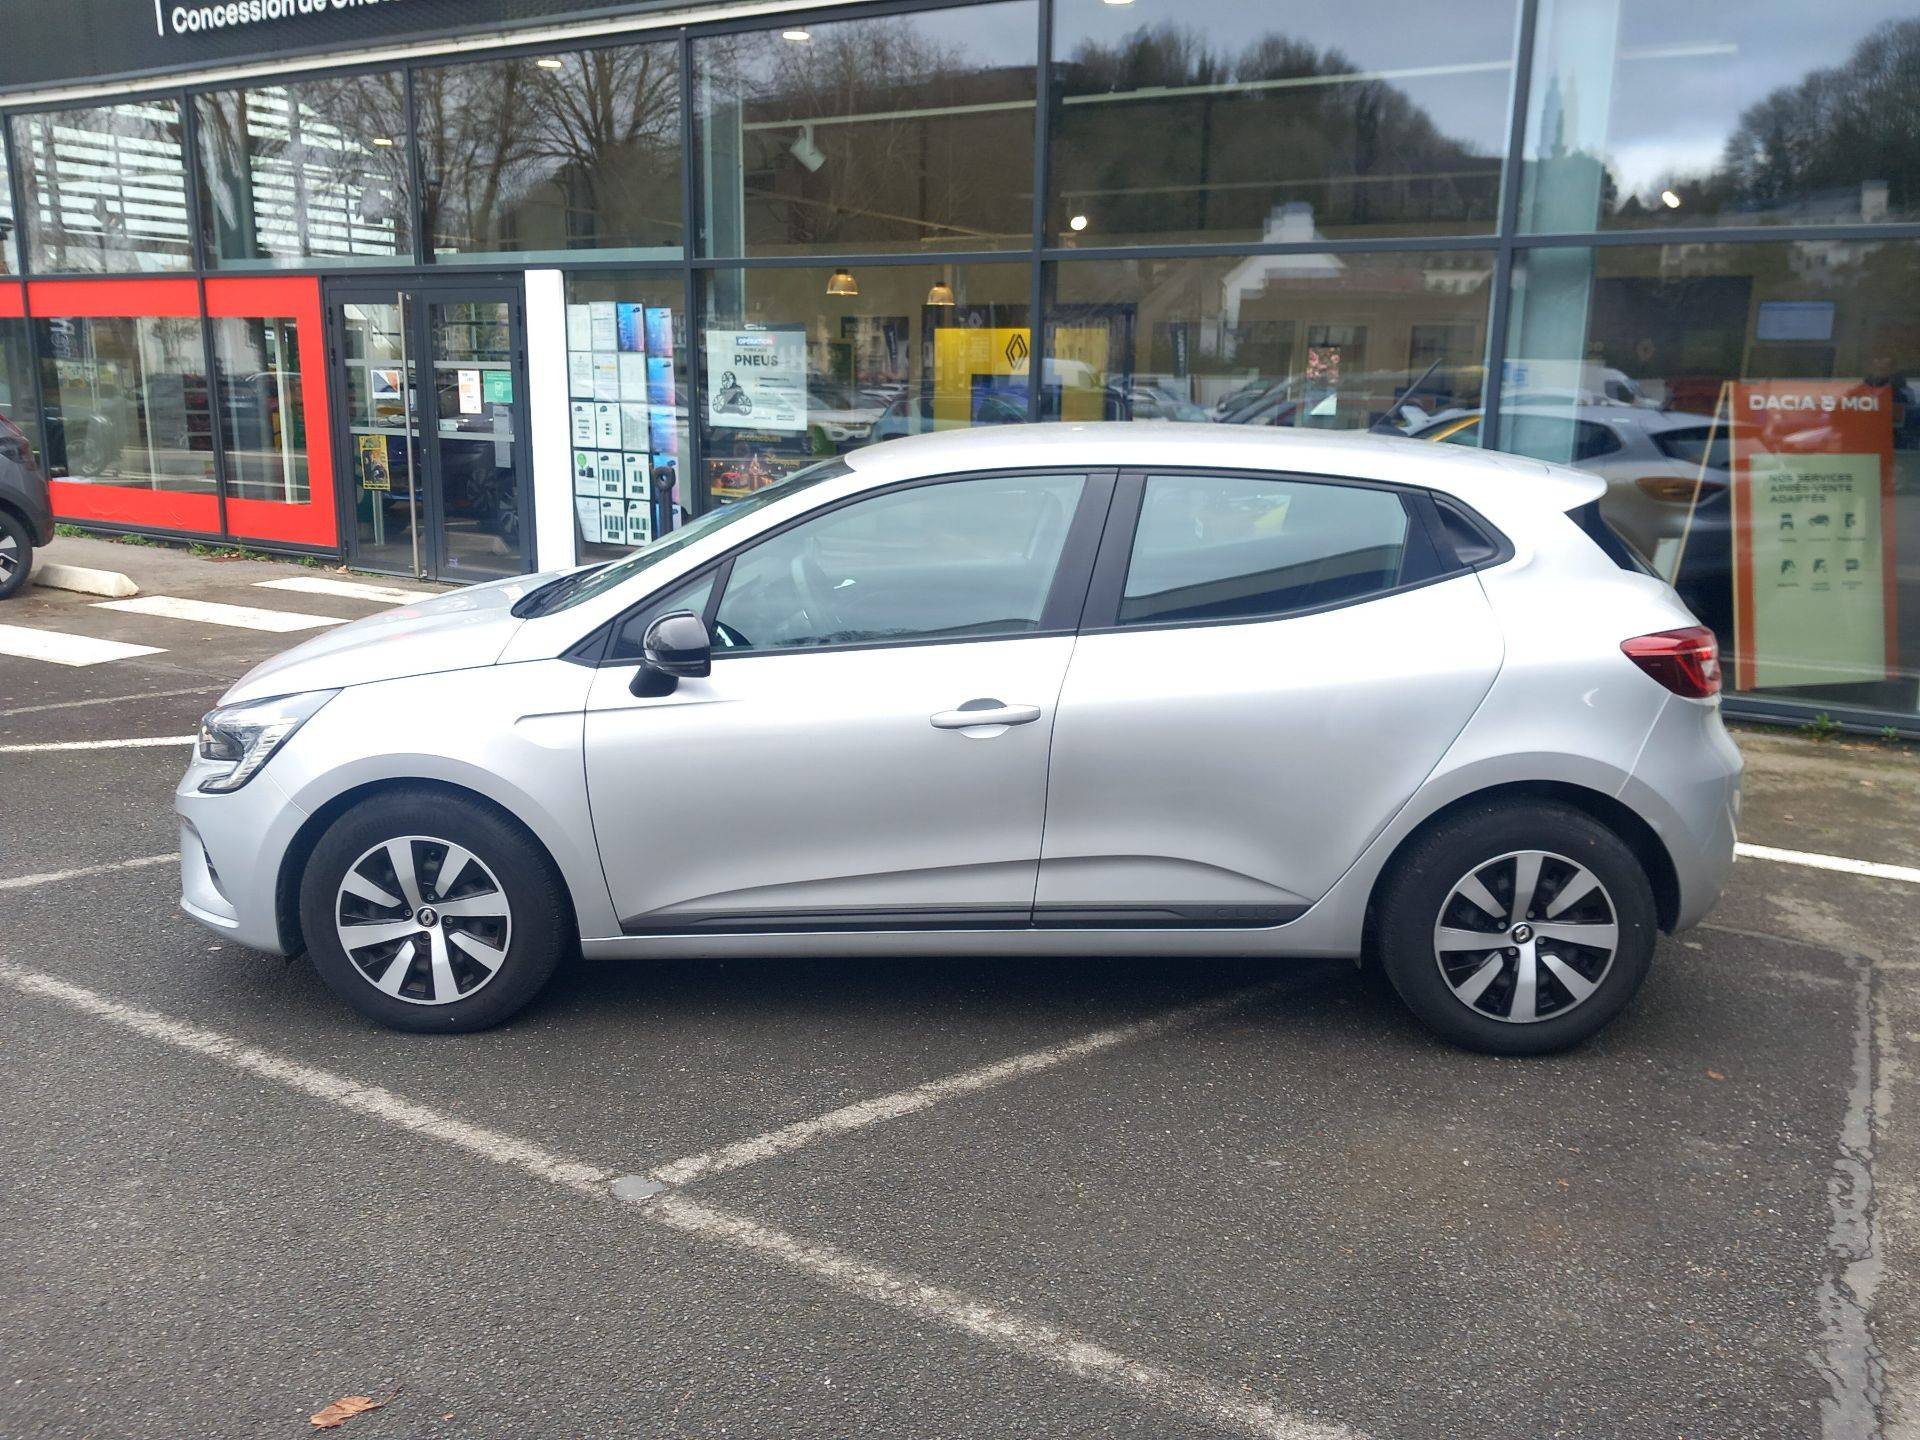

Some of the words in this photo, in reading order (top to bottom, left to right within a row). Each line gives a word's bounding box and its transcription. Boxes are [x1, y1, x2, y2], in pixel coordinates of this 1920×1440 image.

[171, 0, 295, 33] Concession
[734, 354, 778, 366] PNEUS
[1749, 395, 1815, 410] DACIA
[1841, 396, 1880, 410] MOI
[1797, 472, 1853, 482] SERVICES
